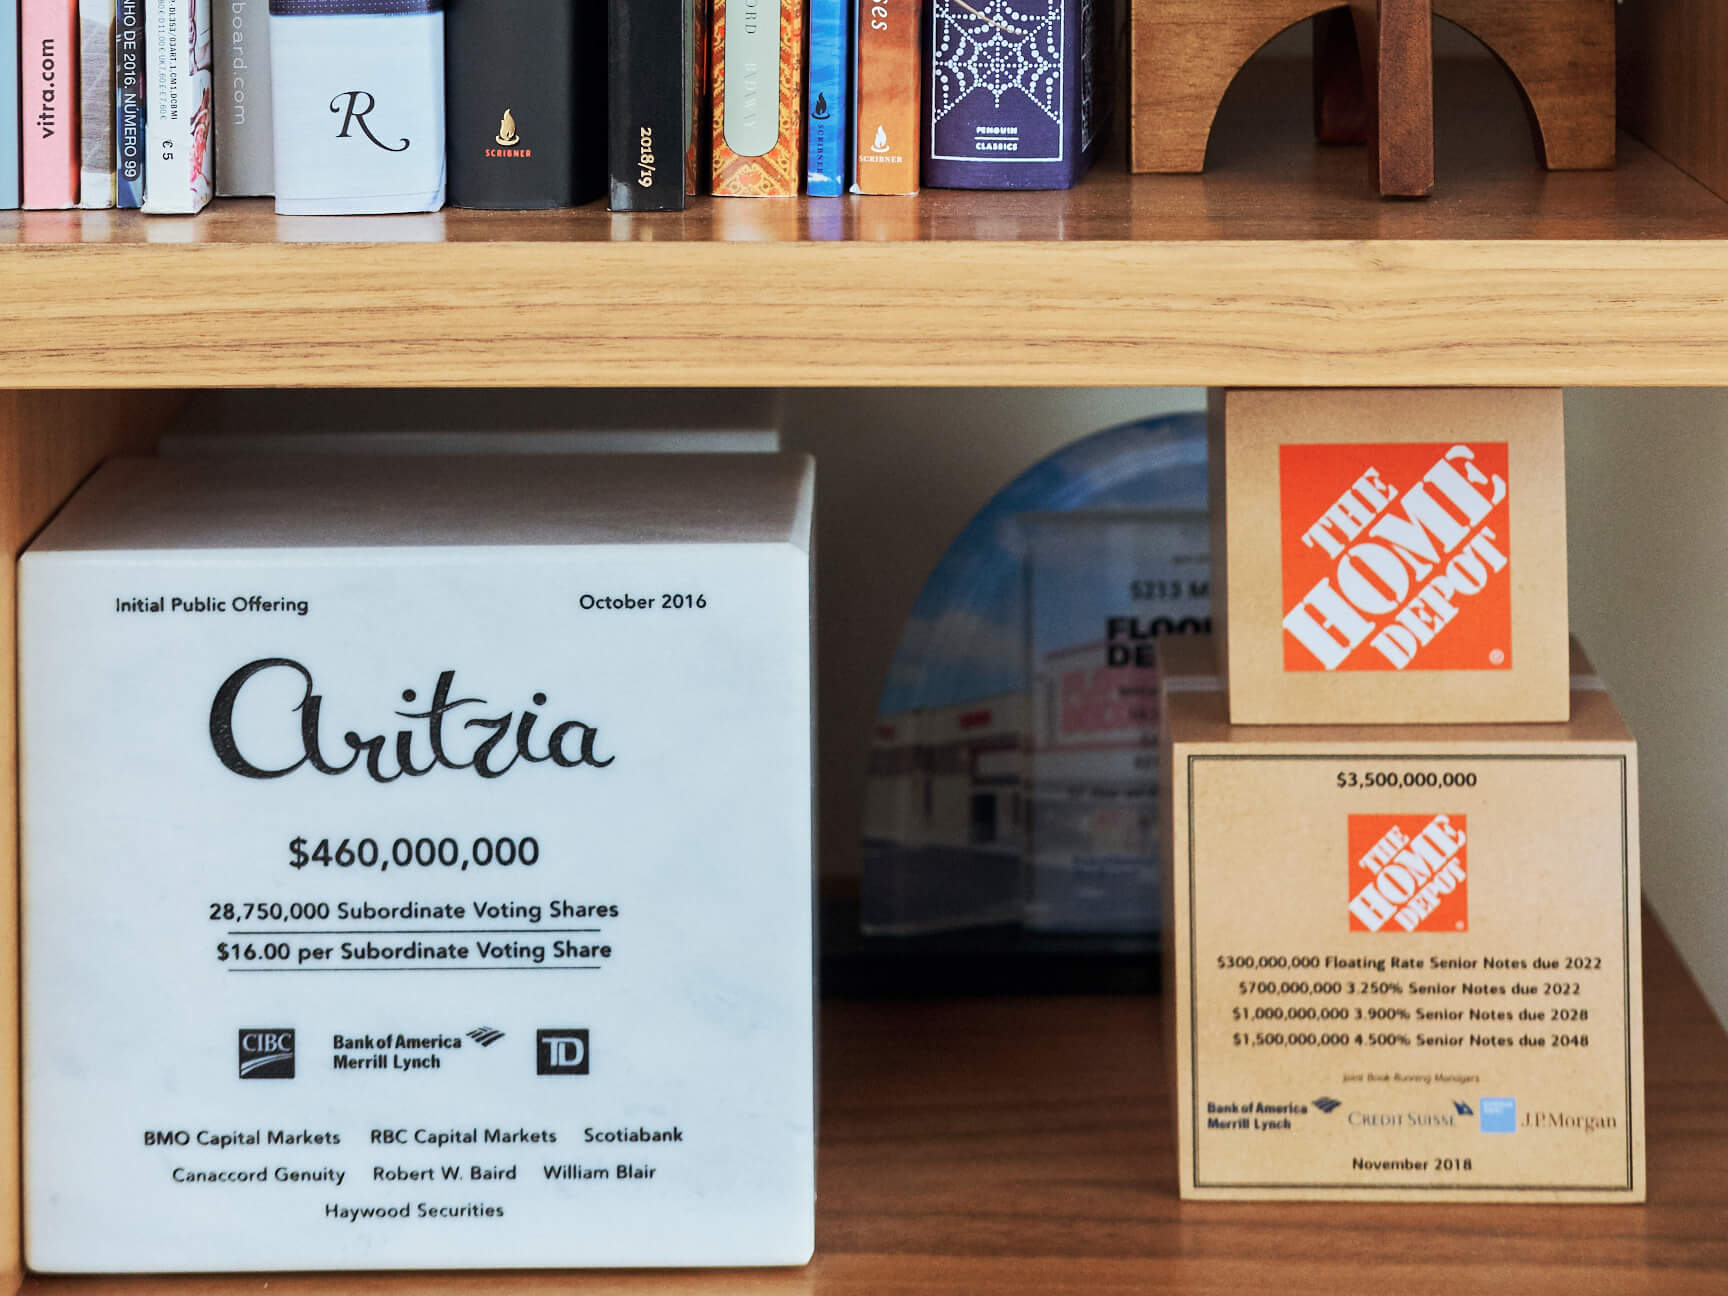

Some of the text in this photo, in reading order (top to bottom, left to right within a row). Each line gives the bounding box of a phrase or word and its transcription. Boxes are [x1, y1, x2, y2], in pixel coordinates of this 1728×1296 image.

[122, 29, 139, 52] DE
[124, 54, 136, 88] 2016.
[36, 38, 57, 139] vitra.com
[124, 92, 141, 156] NÚMERO
[486, 149, 531, 157] SCRIBNER
[976, 142, 1017, 151] CLASSICS
[638, 127, 655, 187] 2018/19
[125, 161, 139, 179] 99
[1300, 465, 1399, 560] THE
[1282, 444, 1507, 671] HOME
[117, 596, 308, 616] Initial Public Offering
[580, 594, 706, 609] October 2016
[1369, 526, 1508, 671] DEPOT
[207, 656, 616, 785] Aritzia
[1337, 772, 1477, 788] $3,500,000,000
[289, 836, 539, 871] $460,000,000
[1358, 825, 1411, 876] THE
[1348, 814, 1467, 932] HOME
[1393, 858, 1467, 932] DEPOT
[210, 900, 619, 923] 28,750,000 Subordinate Voting Shares
[217, 940, 611, 964] $16.00 per Subordinate Voting Share
[1217, 956, 1601, 972] $300,000,000 Floating Rate Senior Notes due 2022
[1239, 981, 1342, 995] $700,000,000
[1409, 982, 1456, 994] Senior
[1462, 983, 1506, 995] Notes
[1512, 983, 1537, 995] due
[1544, 983, 1580, 995] 2022
[1233, 1007, 1349, 1021] $1,000,000,000
[1416, 1008, 1463, 1020] Senior
[1469, 1008, 1513, 1021] Notes
[1519, 1008, 1544, 1021] due
[1551, 1009, 1588, 1021] 2028
[241, 1033, 293, 1053] CIBC
[334, 1034, 461, 1049] Bank of America
[1233, 1032, 1349, 1047] $1,500,000,000
[1416, 1034, 1463, 1046] Senior
[1470, 1034, 1513, 1047] Notes
[1519, 1034, 1545, 1047] due
[1552, 1035, 1588, 1047] 2048
[541, 1035, 585, 1068] TD
[334, 1054, 440, 1071] Merrill Lynch
[1208, 1102, 1307, 1114] Bank of America
[584, 1126, 682, 1142] Scotiabank
[1208, 1118, 1291, 1131] Merrill Lynch
[144, 1130, 340, 1149] BMO Capital Markets
[371, 1128, 556, 1148] RBC Capital Markets
[374, 1165, 516, 1181] Robert W. Baird
[544, 1164, 656, 1179] William Blair
[1353, 1158, 1472, 1170] November 2018
[173, 1167, 345, 1186] Canaccord Genuity
[326, 1203, 504, 1222] Haywood Securities
